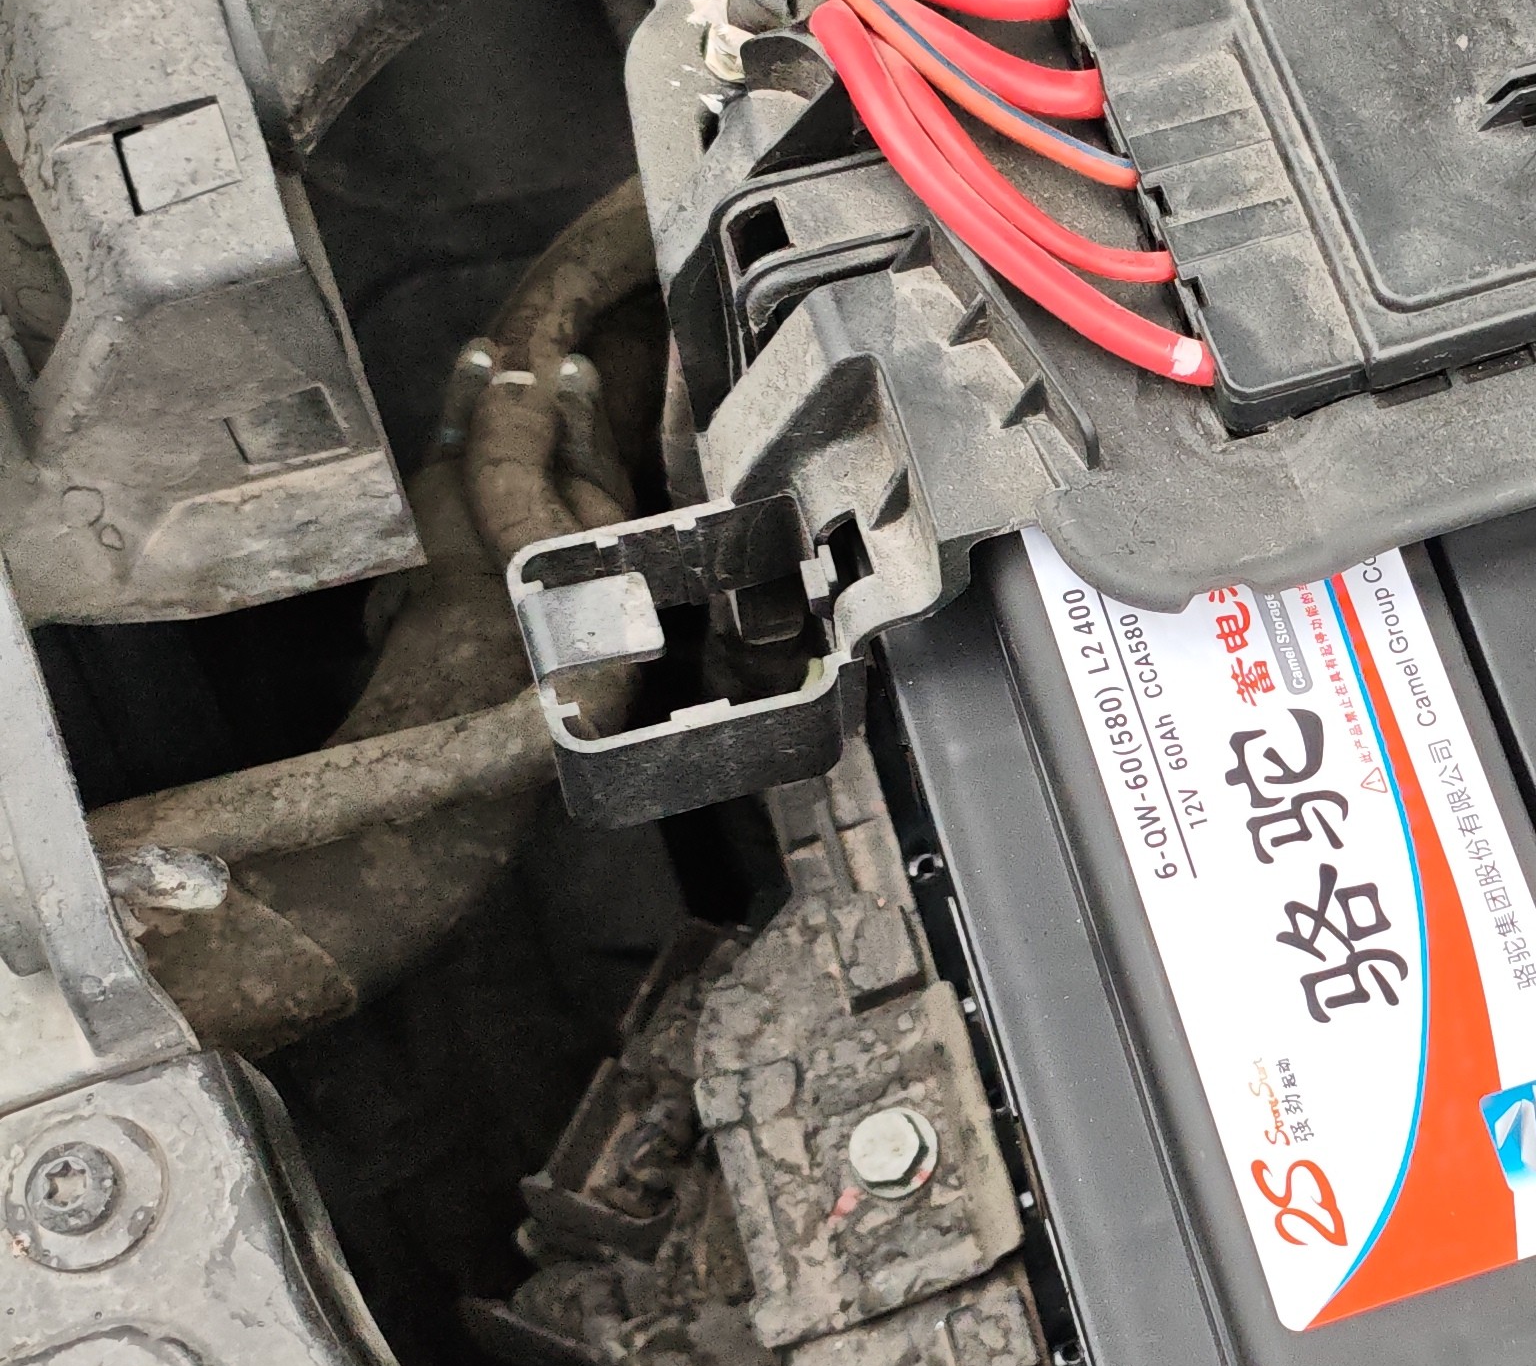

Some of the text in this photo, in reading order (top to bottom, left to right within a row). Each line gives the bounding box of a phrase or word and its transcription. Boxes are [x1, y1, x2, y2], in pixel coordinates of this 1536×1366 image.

[1264, 593, 1306, 689] Camel Storage
[1375, 588, 1408, 653] Group
[1063, 589, 1177, 879] 6-QW-60(580) L2 400
[1120, 614, 1207, 829] 12V 60Ah CCA580
[1396, 659, 1436, 726] Camel
[1225, 709, 1408, 1023] 骆驼
[1252, 1160, 1348, 1246] 2S
